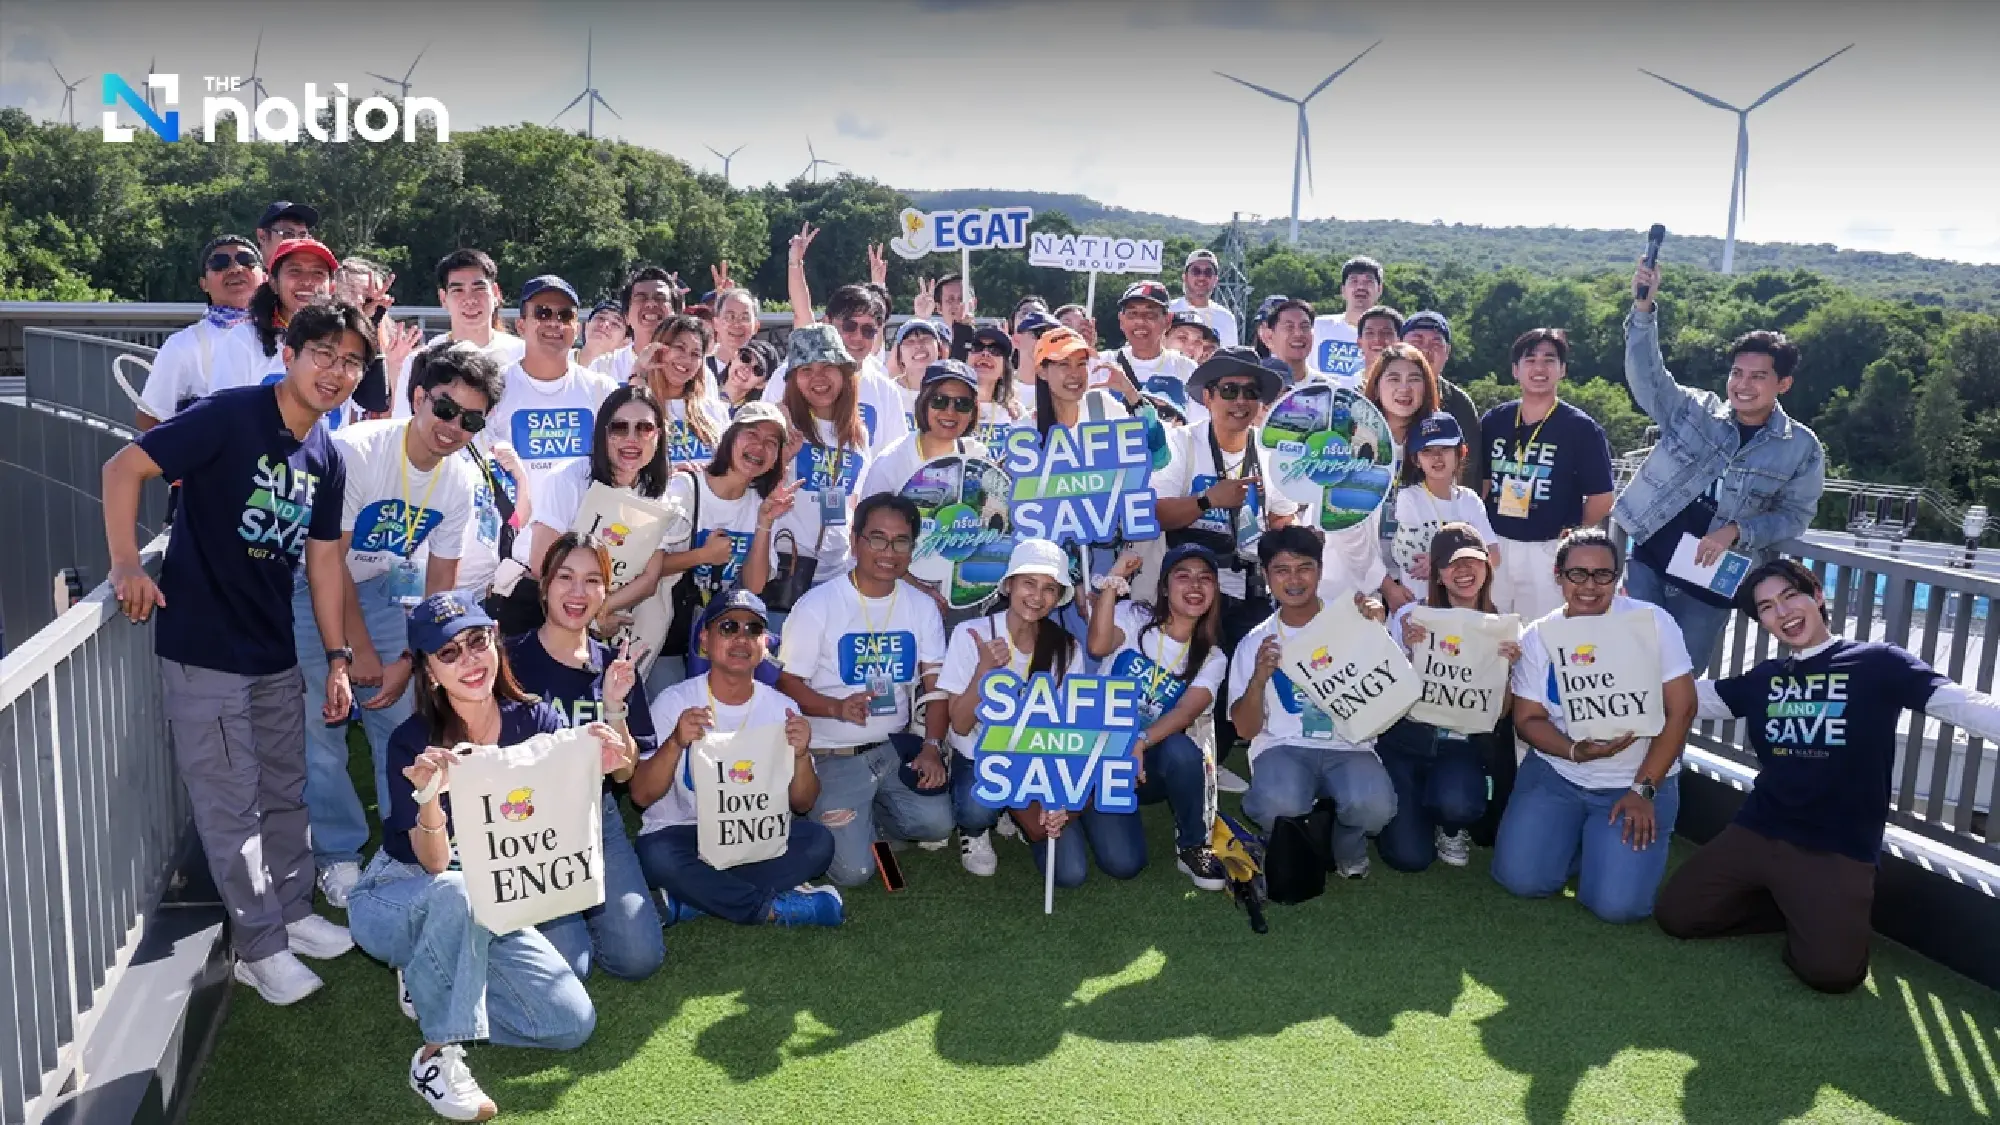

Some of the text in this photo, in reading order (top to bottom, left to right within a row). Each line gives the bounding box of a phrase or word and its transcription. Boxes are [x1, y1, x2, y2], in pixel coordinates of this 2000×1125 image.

[934, 212, 1029, 249] EGAT
[1034, 237, 1158, 261] NATION
[1065, 258, 1126, 270] GROUP
[1329, 342, 1361, 357] SAF
[1327, 360, 1353, 373] SAV
[528, 411, 581, 434] SAFE
[528, 432, 582, 455] SAVE
[1279, 442, 1304, 454] EGAT
[1008, 421, 1147, 498] SAFE
[1056, 473, 1105, 495] AND
[1491, 468, 1552, 500] SE
[1014, 468, 1155, 541] SAVE
[854, 635, 903, 660] SAFE
[1429, 631, 1436, 651] I
[853, 655, 904, 681] SAVE
[1296, 660, 1313, 680] I
[1424, 654, 1473, 683] love
[1557, 647, 1568, 667] I
[1128, 656, 1181, 698] SAE
[1311, 661, 1359, 700] love
[1328, 659, 1398, 721] ENGY
[1561, 670, 1615, 693] love
[1421, 679, 1492, 714] ENGY
[1767, 673, 1849, 712] SAFE
[981, 674, 1136, 751] SAFE
[1567, 691, 1649, 722] ENGY
[1786, 702, 1816, 715] AND
[1765, 703, 1847, 746] SAVE
[1028, 731, 1084, 751] AND
[717, 761, 726, 784] I
[976, 733, 1133, 806] SAVE
[480, 794, 495, 825] I
[717, 789, 769, 814] love
[718, 811, 791, 846] ENGY
[484, 827, 558, 861] love
[491, 846, 592, 904] ENGY
